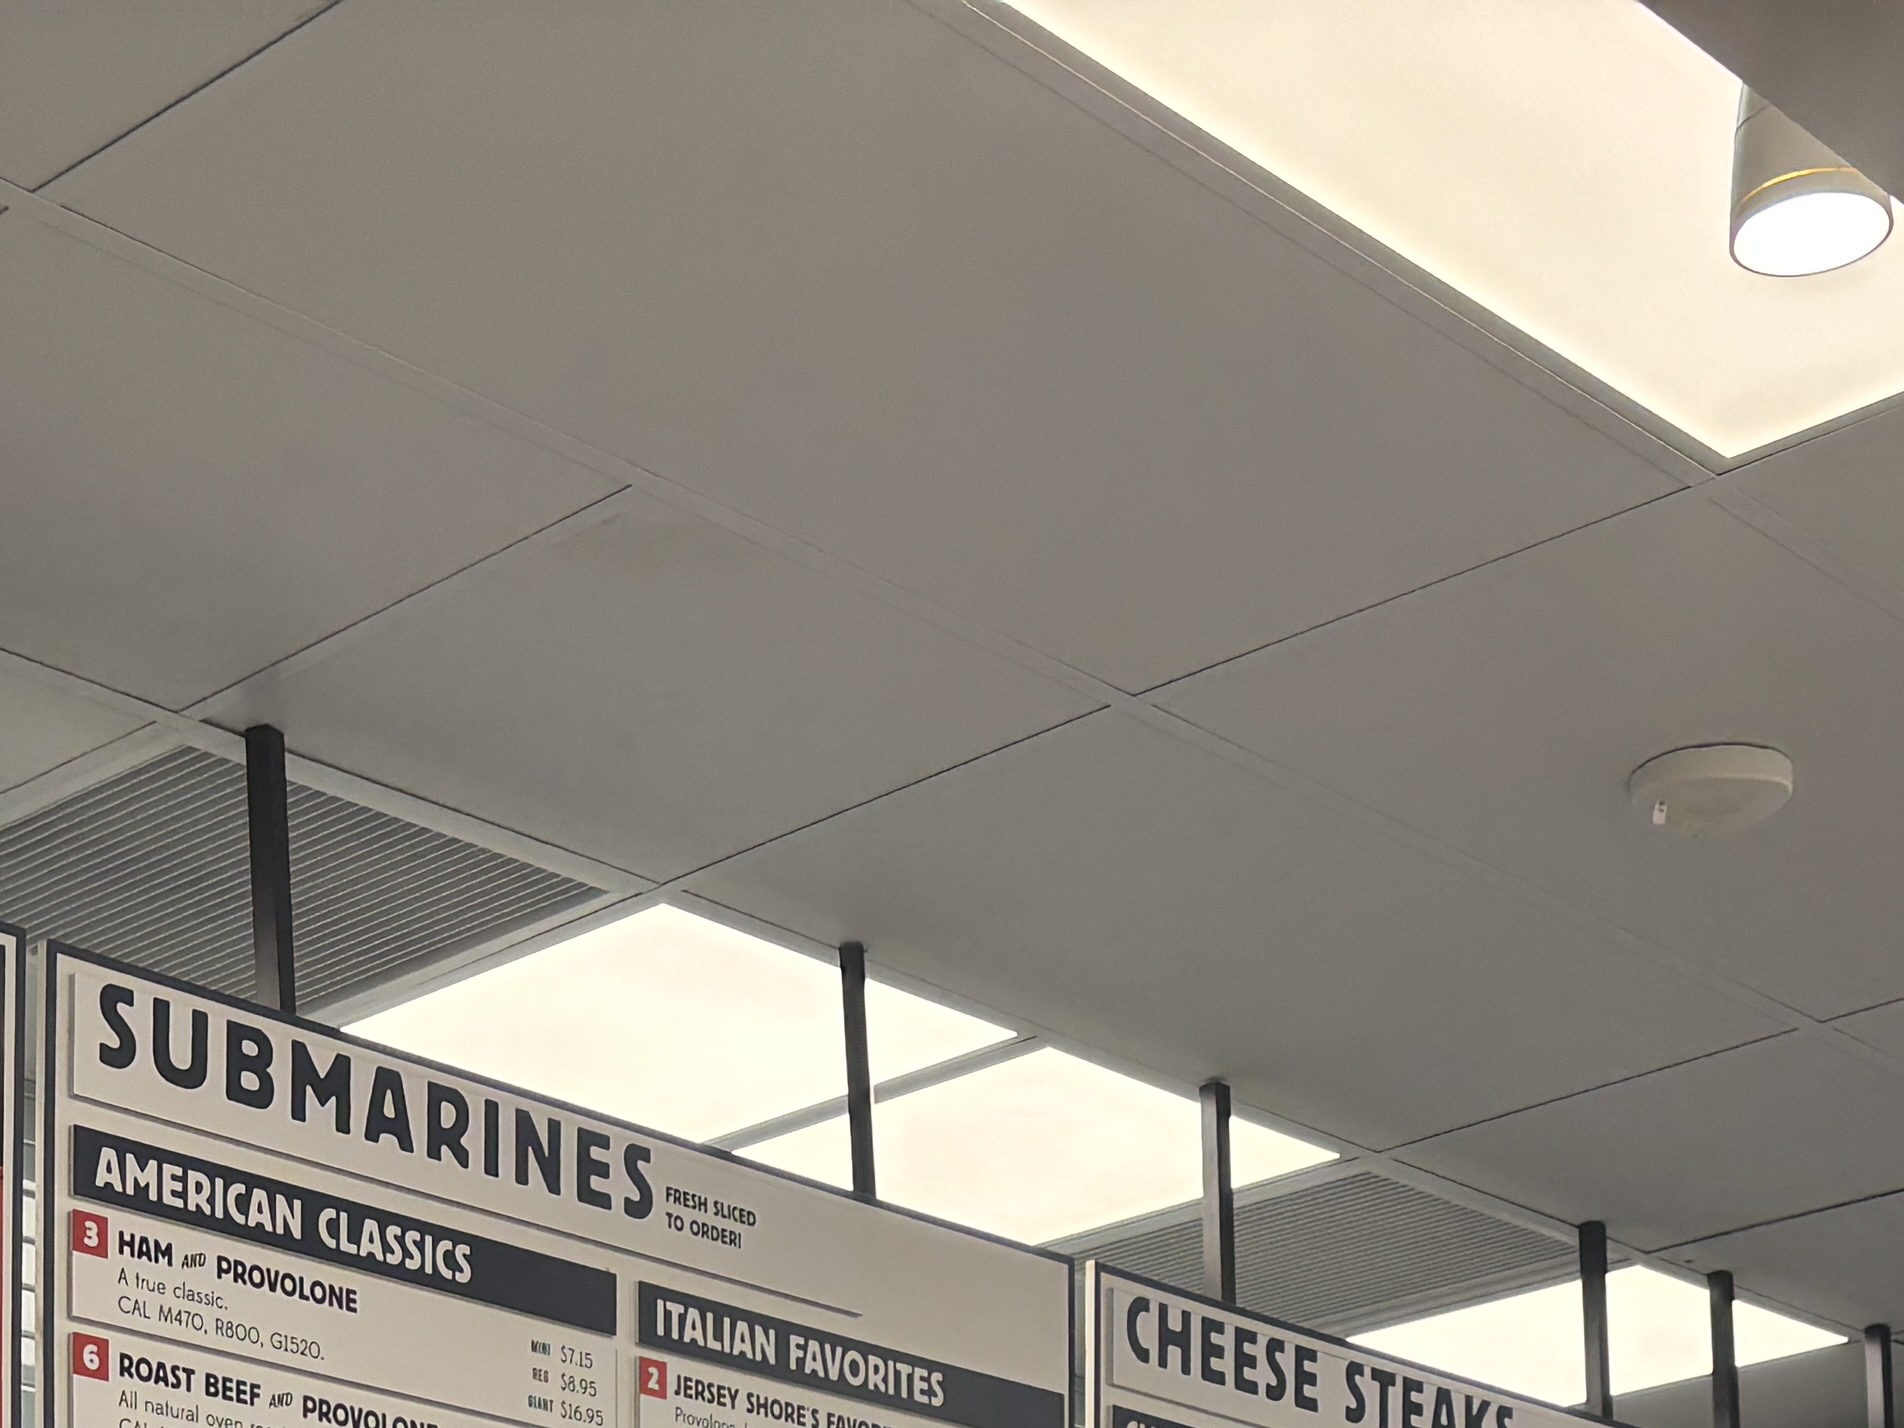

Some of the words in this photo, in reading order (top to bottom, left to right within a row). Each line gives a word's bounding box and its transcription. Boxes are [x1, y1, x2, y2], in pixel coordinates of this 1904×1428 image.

[99, 983, 654, 1219] SUBMARINES
[96, 1147, 302, 1240] AMERICAN
[319, 1208, 473, 1284] CLASSICS
[665, 1212, 684, 1231] TO
[666, 1186, 708, 1213] FRESH
[713, 1200, 756, 1226] SLICED
[83, 1220, 98, 1248] 3
[119, 1231, 173, 1268] HAM
[216, 1255, 359, 1314] PROVOLONE
[118, 1268, 130, 1286] A
[135, 1271, 166, 1295] true
[173, 1283, 229, 1311] classic.
[118, 1296, 151, 1320] CAL
[158, 1306, 208, 1336] M470,
[560, 1346, 593, 1369] $7.15
[655, 1299, 776, 1365] ITALIAN
[789, 1335, 946, 1406] FAVORITES
[1126, 1296, 1319, 1413] CHEESE
[83, 1344, 99, 1370] 6
[119, 1353, 196, 1393] ROAST
[205, 1374, 261, 1408] BEEF
[560, 1375, 597, 1398] $8.95
[646, 1367, 660, 1390] 2
[674, 1374, 739, 1410] JERSEY
[560, 1402, 604, 1427] $16.95
